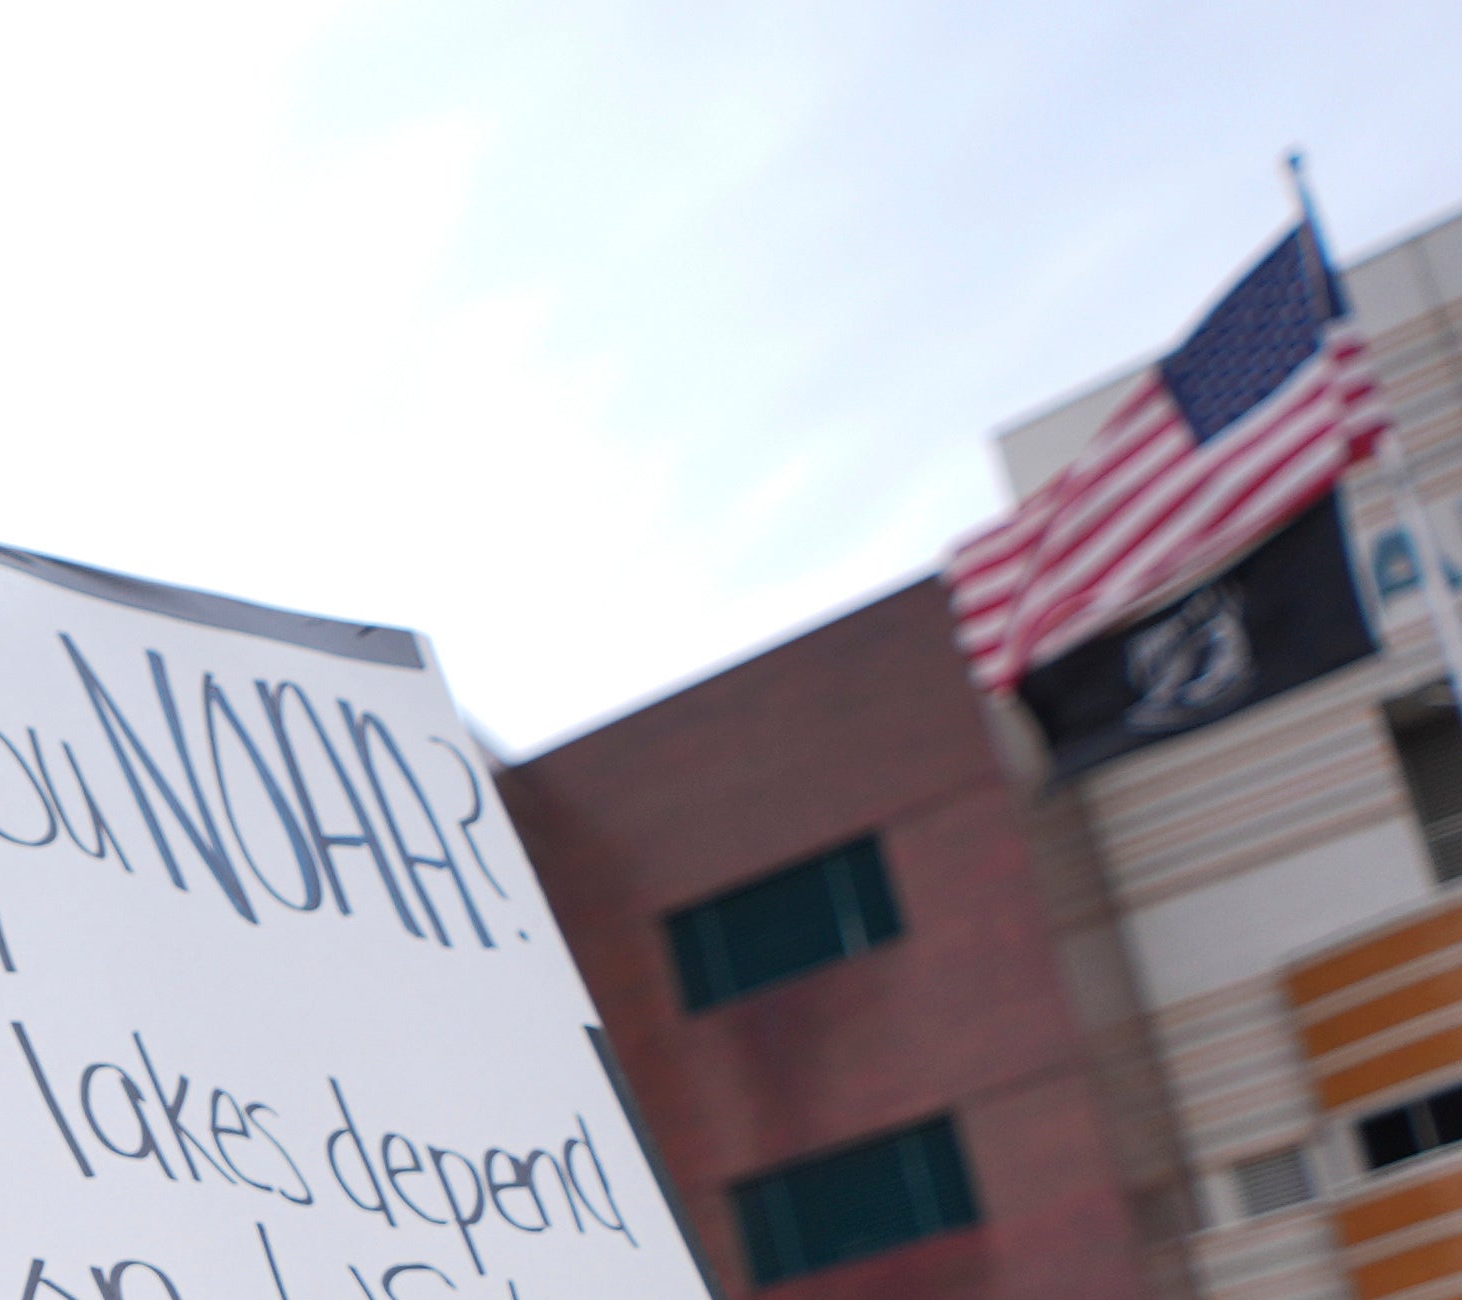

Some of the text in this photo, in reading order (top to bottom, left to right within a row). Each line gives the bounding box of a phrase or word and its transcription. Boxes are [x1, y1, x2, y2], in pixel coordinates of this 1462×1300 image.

[58, 631, 529, 948] NOAA?
[9, 1020, 313, 1206] lakes
[326, 1075, 637, 1275] depend
